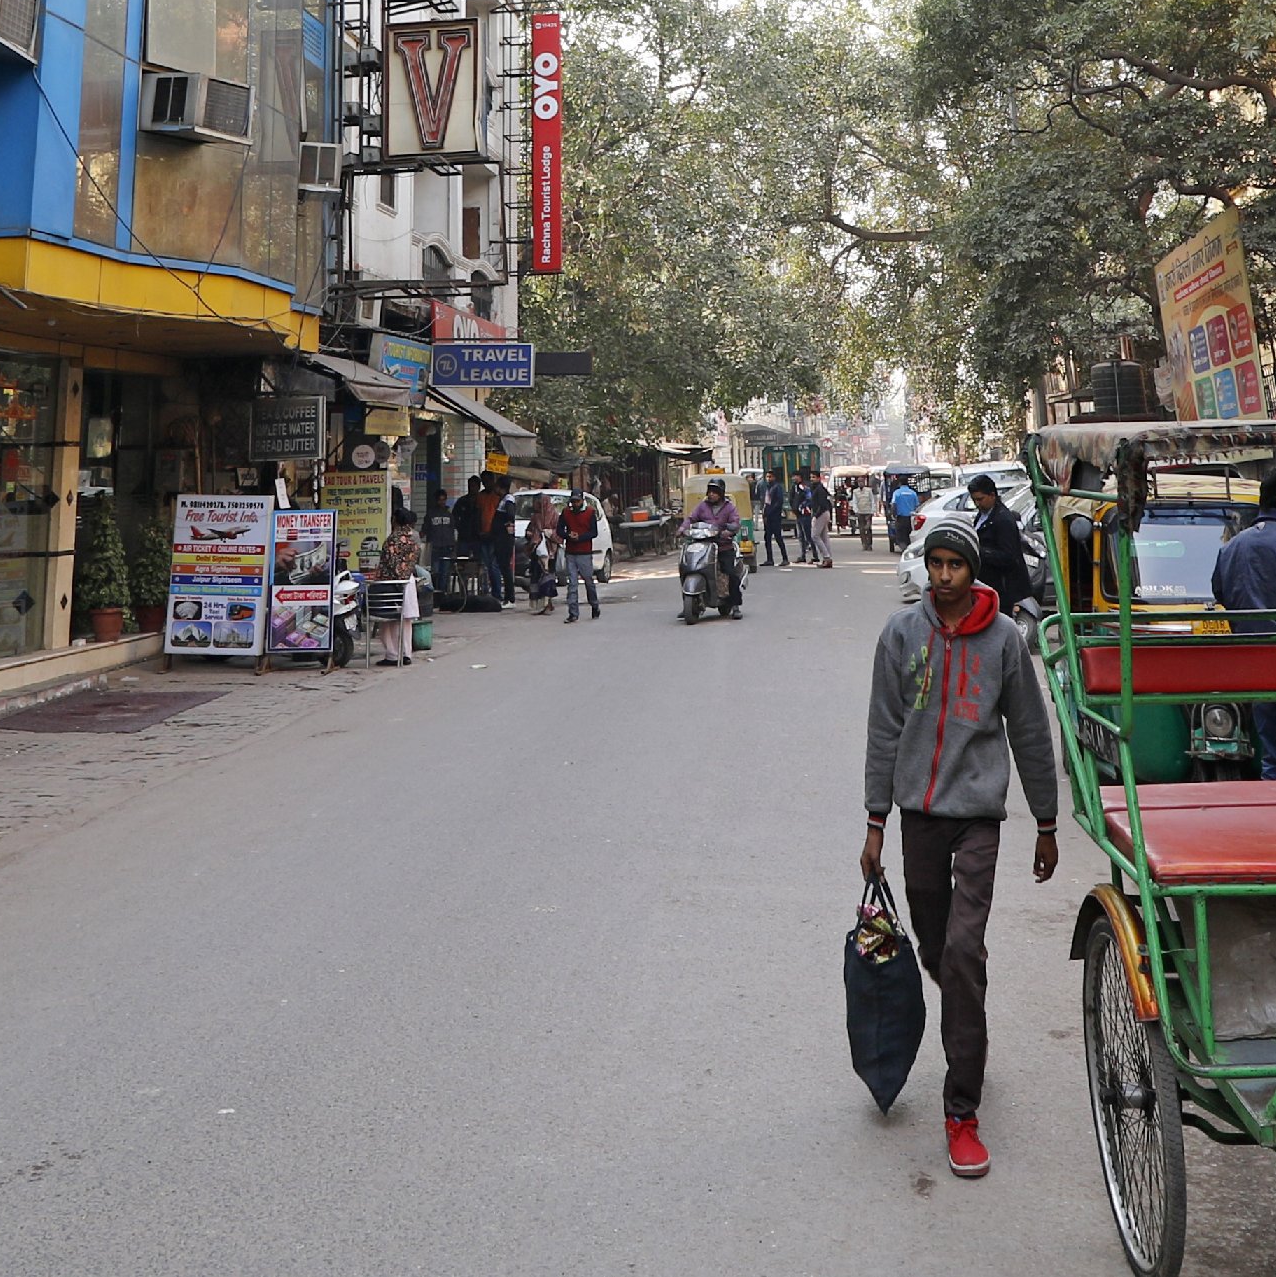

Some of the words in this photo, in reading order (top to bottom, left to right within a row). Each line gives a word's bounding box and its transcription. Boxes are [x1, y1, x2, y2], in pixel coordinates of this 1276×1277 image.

[534, 52, 558, 120] OYO
[541, 145, 553, 180] Lodge
[541, 182, 551, 221] Tourist
[541, 221, 551, 263] Rachna
[461, 349, 528, 362] TRAVEL
[460, 368, 529, 382] LEAGUE
[283, 405, 316, 420] COFFEE
[288, 421, 316, 435] WATER
[283, 438, 316, 452] BUTTER
[359, 474, 385, 485] TRAVELS
[185, 509, 205, 522] Free
[207, 509, 238, 523] Tourist
[239, 510, 259, 523] Info.
[276, 514, 299, 528] MONEY
[300, 514, 332, 528] TRANSFER
[182, 545, 192, 553] AIR
[192, 545, 212, 553] TICKET
[195, 554, 211, 562] Delhi
[195, 565, 210, 574] Agra
[192, 576, 212, 584] Jaipur
[203, 601, 213, 609] 24
